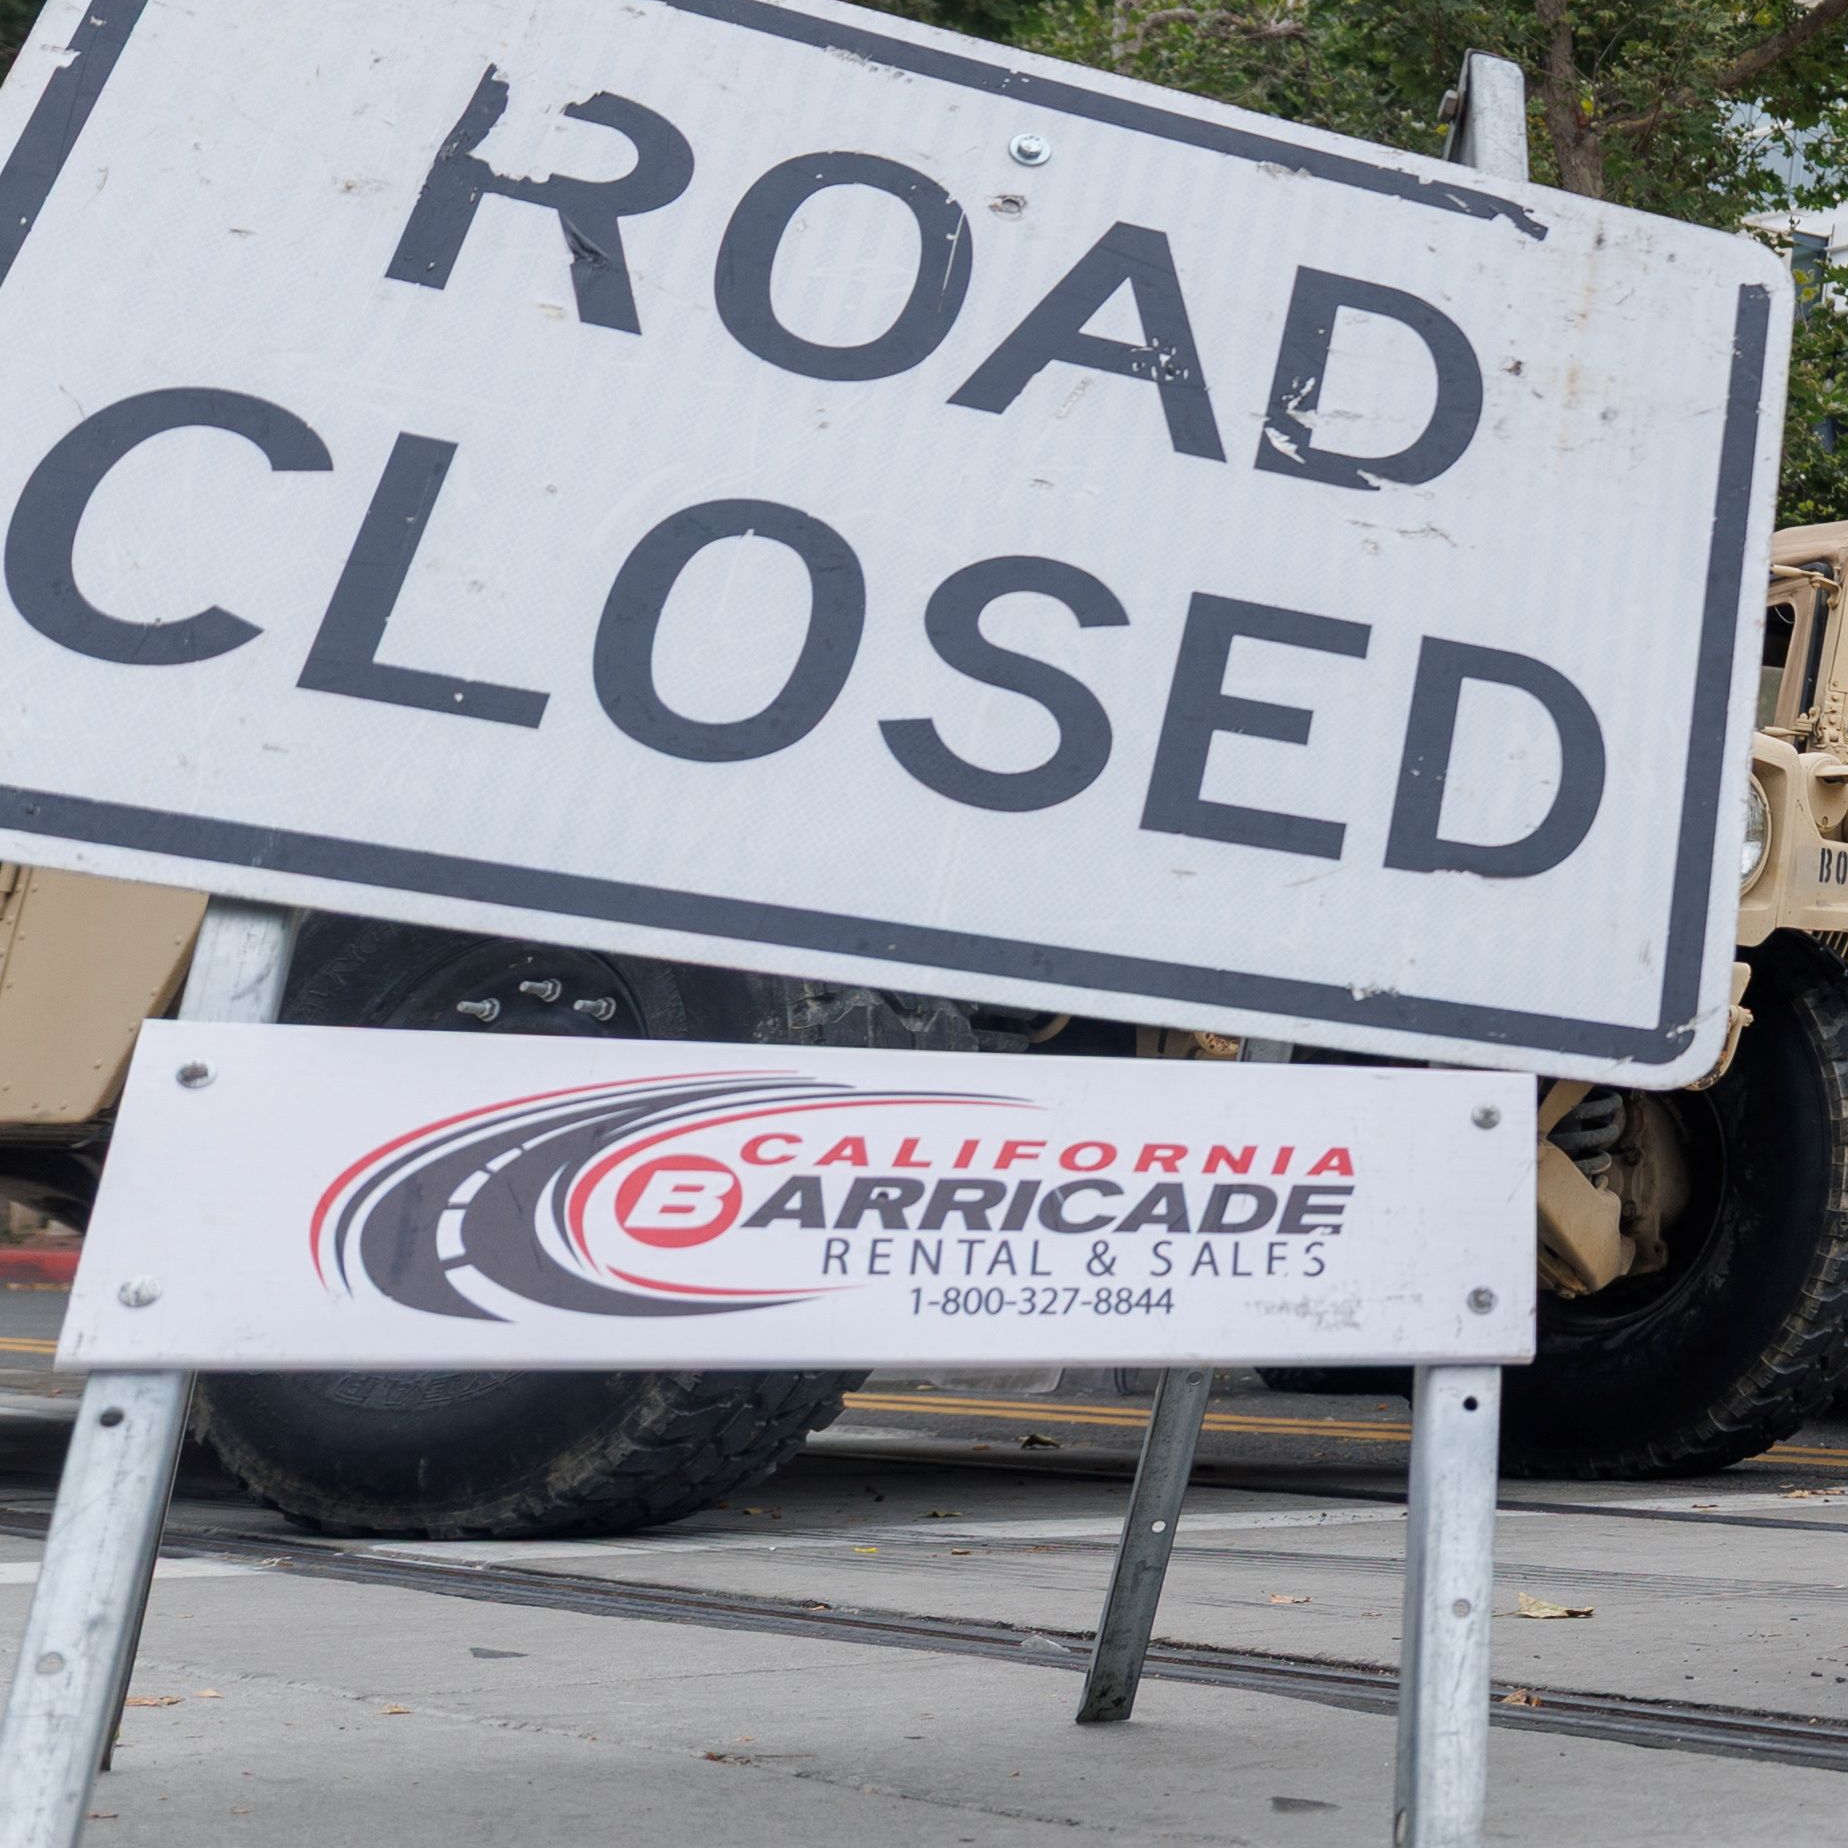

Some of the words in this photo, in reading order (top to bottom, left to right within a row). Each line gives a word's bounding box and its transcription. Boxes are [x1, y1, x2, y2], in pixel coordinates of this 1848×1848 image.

[384, 62, 1484, 492] ROAD
[3, 385, 1606, 880] CLOSED
[739, 1132, 1355, 1177] CALIFORNIA
[622, 1169, 1355, 1236] BARRICADE
[821, 1237, 1053, 1277] RENTAL
[1086, 1240, 1117, 1278] &
[1150, 1240, 1326, 1279] SALES
[909, 1286, 1174, 1317] 1-800-327-8844
